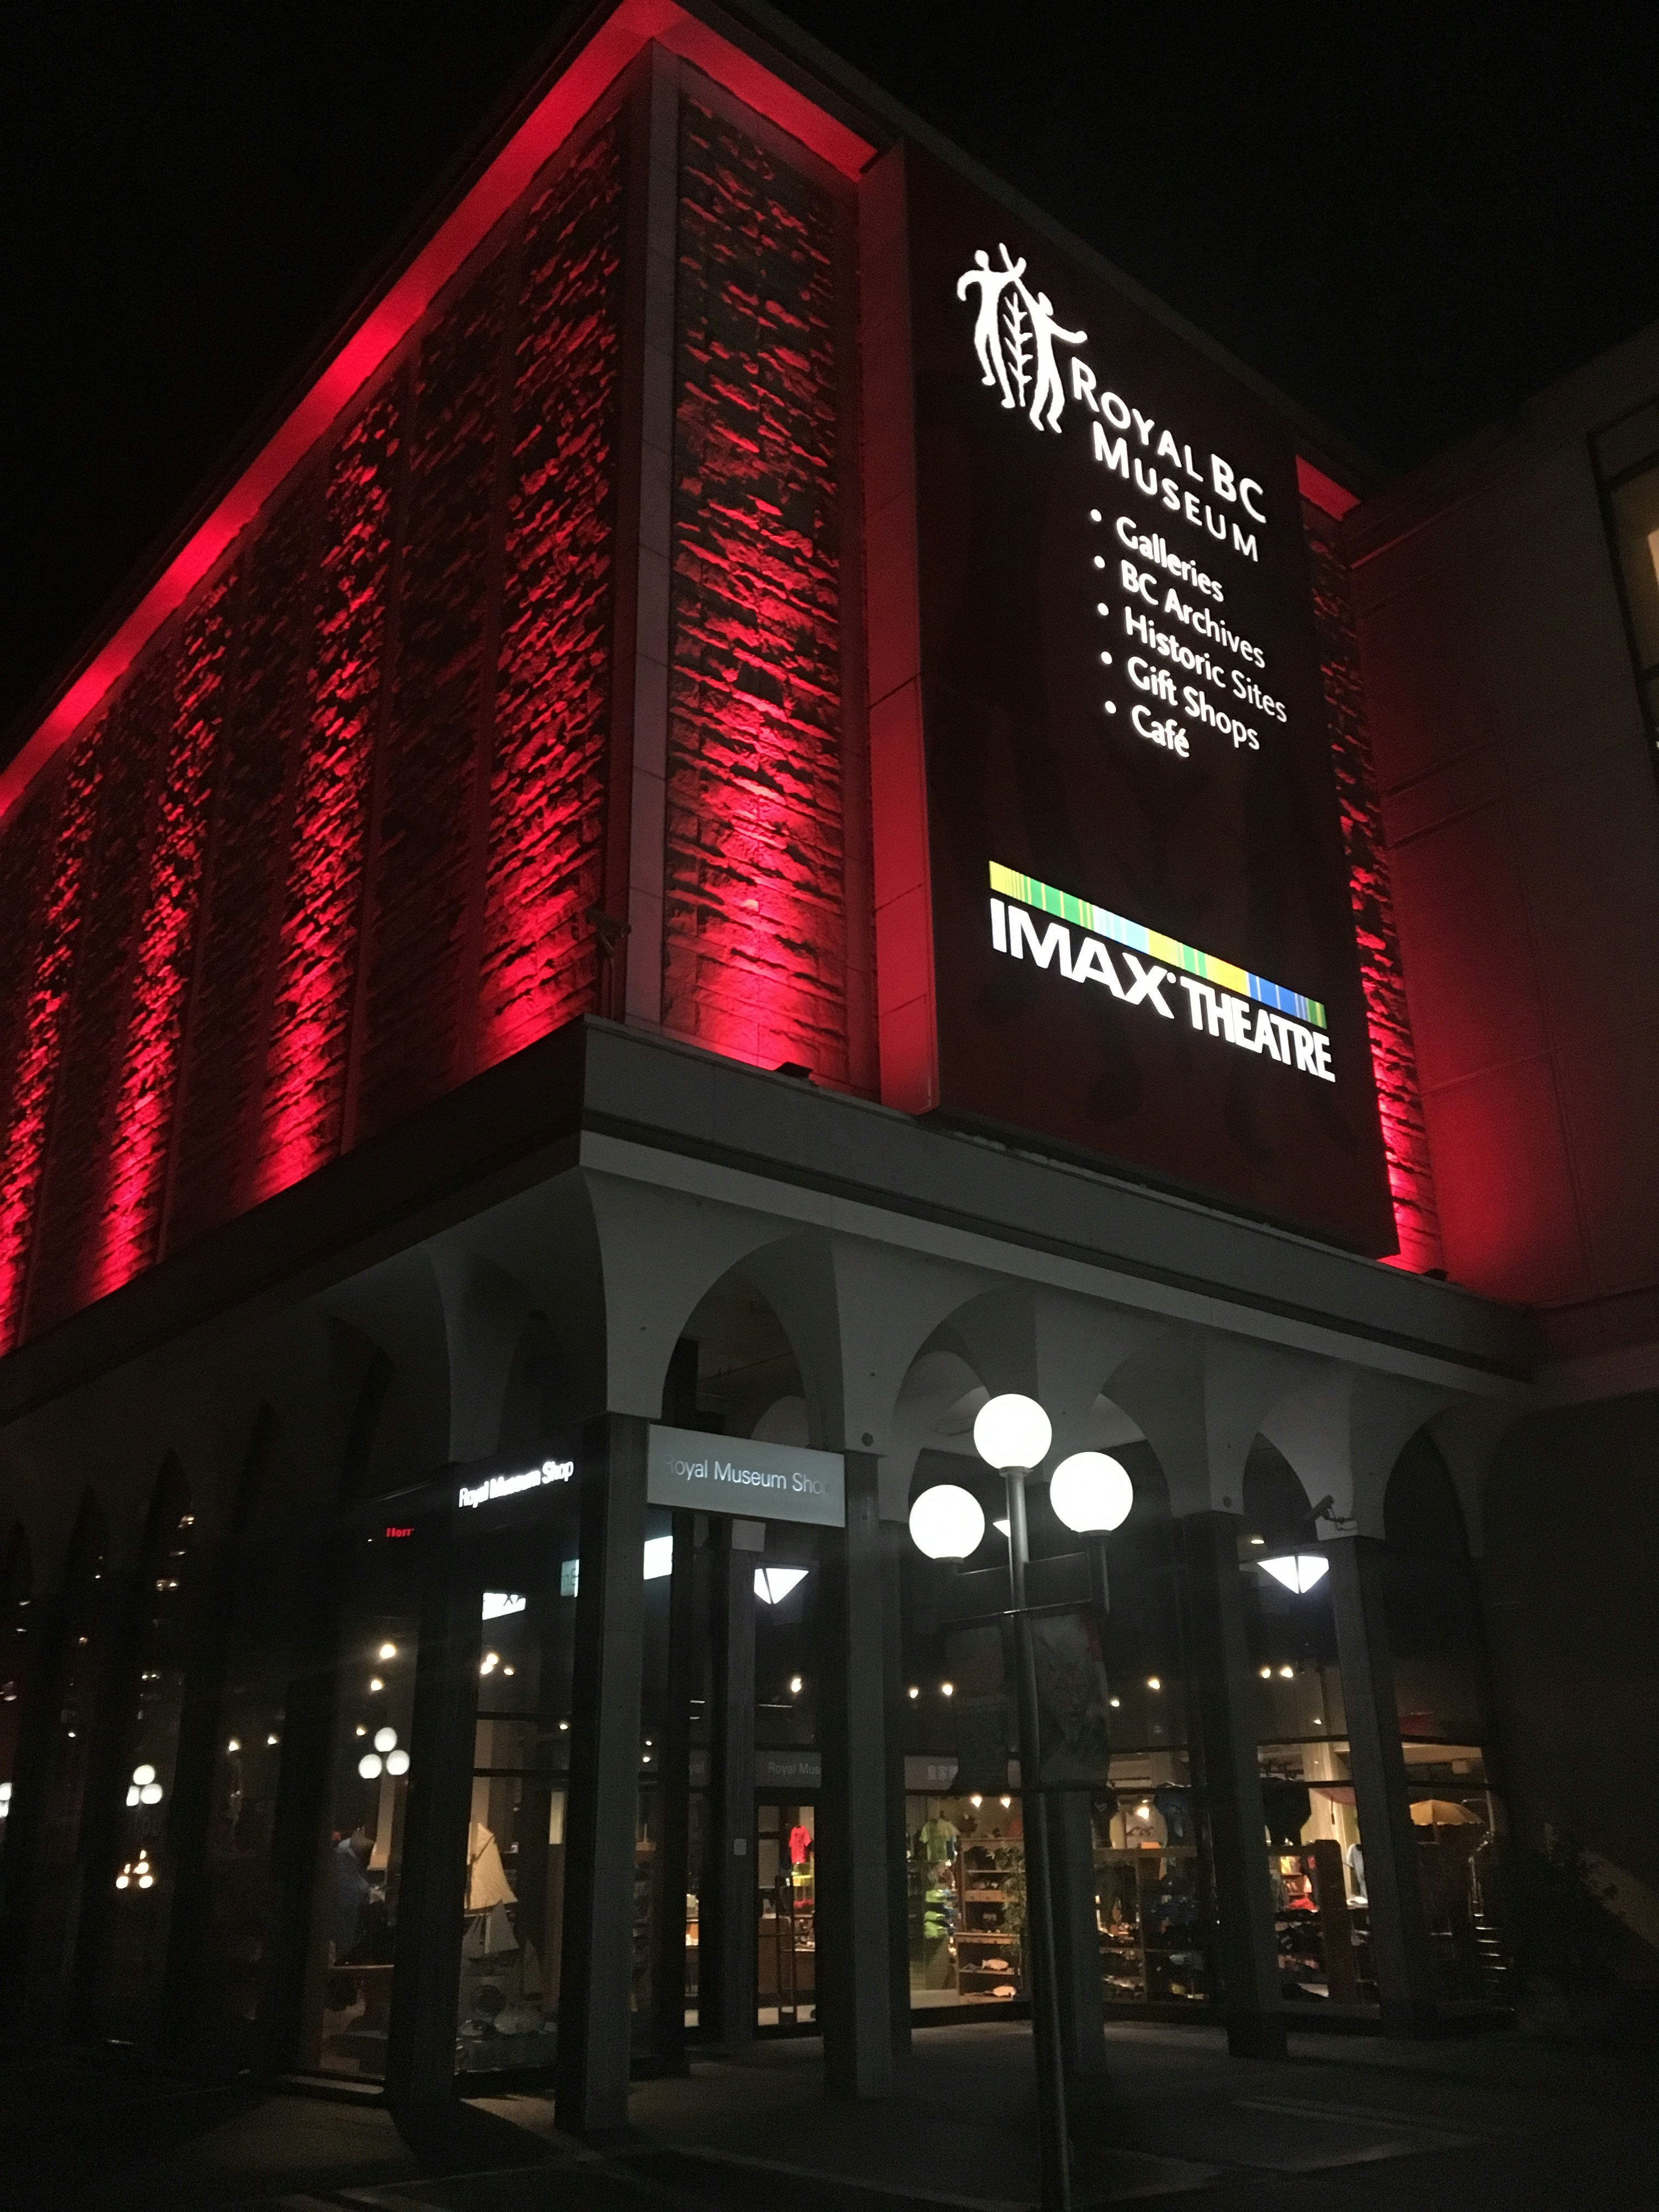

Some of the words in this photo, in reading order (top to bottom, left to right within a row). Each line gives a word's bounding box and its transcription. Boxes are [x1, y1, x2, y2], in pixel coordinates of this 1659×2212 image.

[1071, 356, 1204, 482] ROYAL
[1210, 453, 1266, 524] BC
[1092, 421, 1259, 562] MUSEUM
[1115, 516, 1224, 602] Galleries
[1121, 558, 1159, 606] BC
[1164, 588, 1266, 668] Archives
[1124, 605, 1226, 689] Historic
[1231, 669, 1287, 723] Sites
[1127, 656, 1178, 707] Gift
[1183, 685, 1260, 751] Shops
[1131, 704, 1190, 758] Café
[990, 897, 1177, 1019] IMAX
[1180, 975, 1336, 1083] THEATRE
[459, 1480, 489, 1508] Royal
[541, 1461, 574, 1484] Shop
[714, 1461, 787, 1489] Museum
[768, 1762, 796, 1778] Royal
